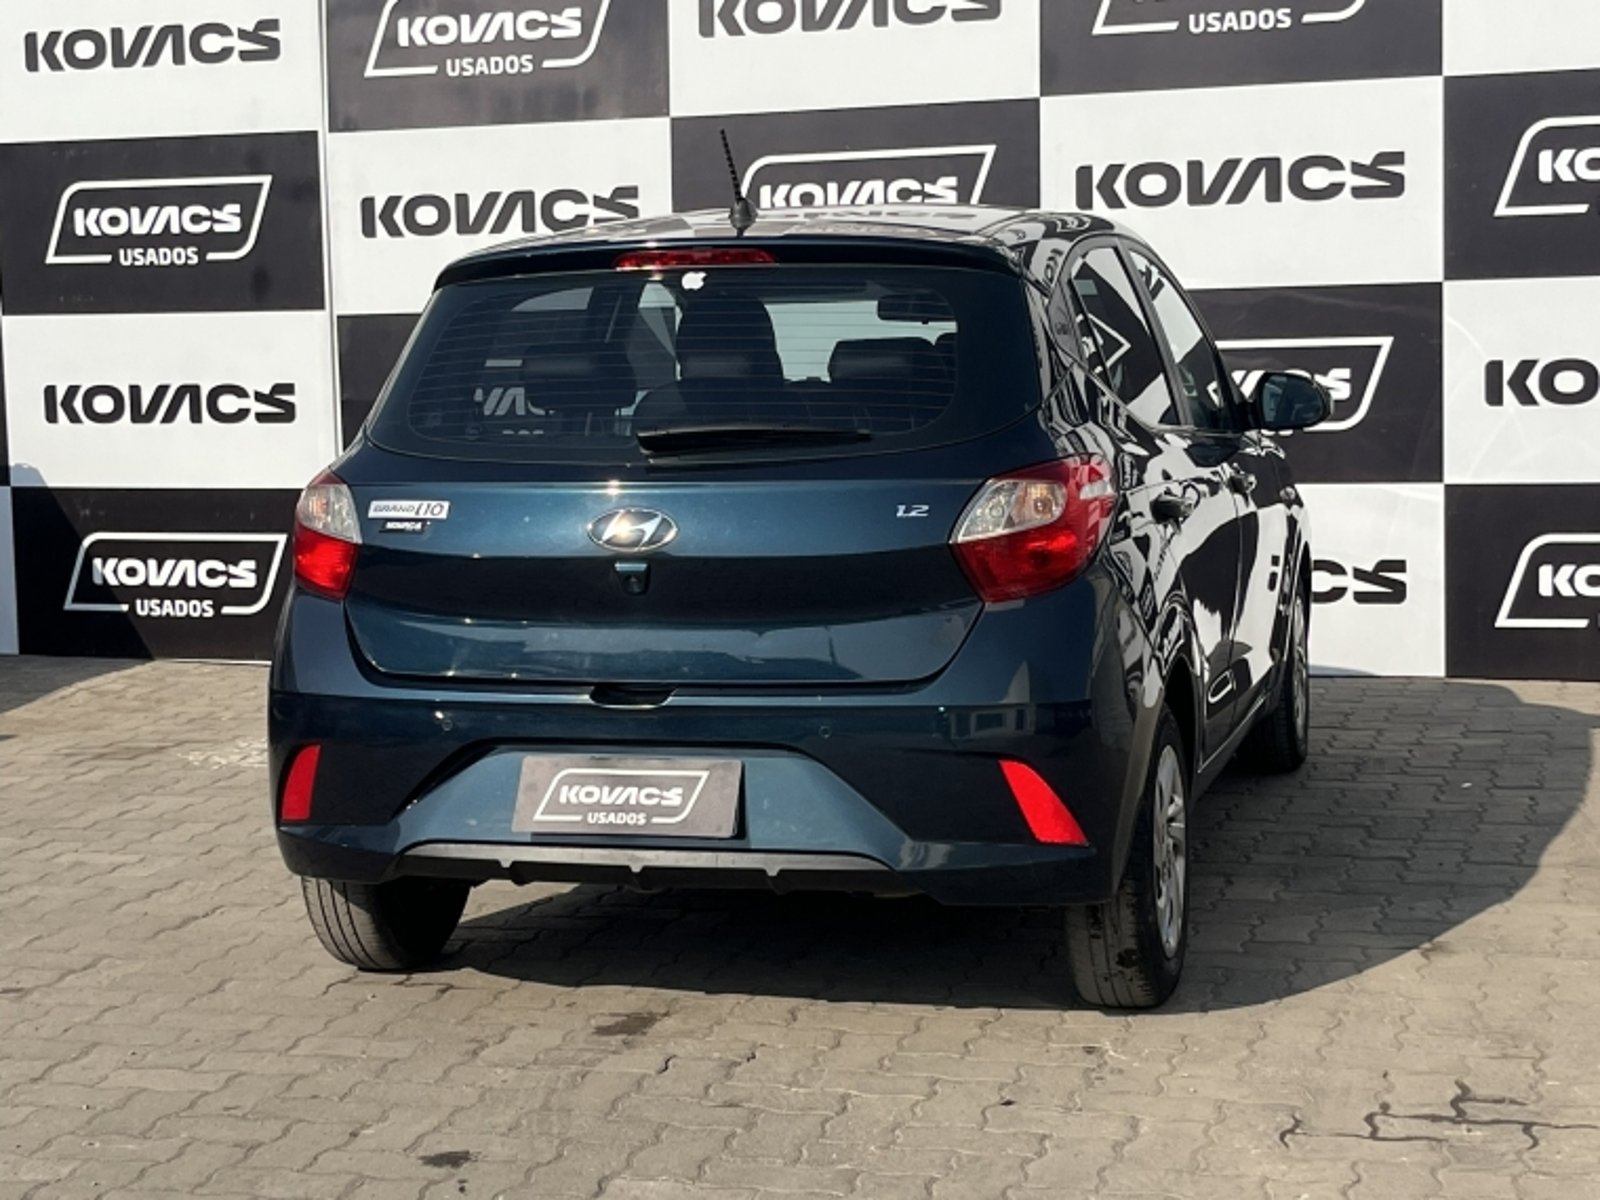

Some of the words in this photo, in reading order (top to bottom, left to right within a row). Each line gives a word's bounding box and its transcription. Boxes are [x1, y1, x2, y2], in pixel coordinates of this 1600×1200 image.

[396, 7, 582, 48] KOVACS
[1188, 7, 1292, 35] USADOS
[24, 18, 281, 73] KOVACS
[445, 54, 534, 77] USADOS
[1075, 151, 1406, 211] KOVACS
[73, 203, 242, 237] KOVACS
[360, 185, 640, 238] KOVACS
[119, 247, 199, 266] USADOS
[43, 383, 296, 424] KOVACS
[92, 557, 258, 588] KOVACS
[135, 599, 215, 618] USADOS
[558, 784, 683, 807] KOVACS
[586, 812, 647, 826] USADOS
